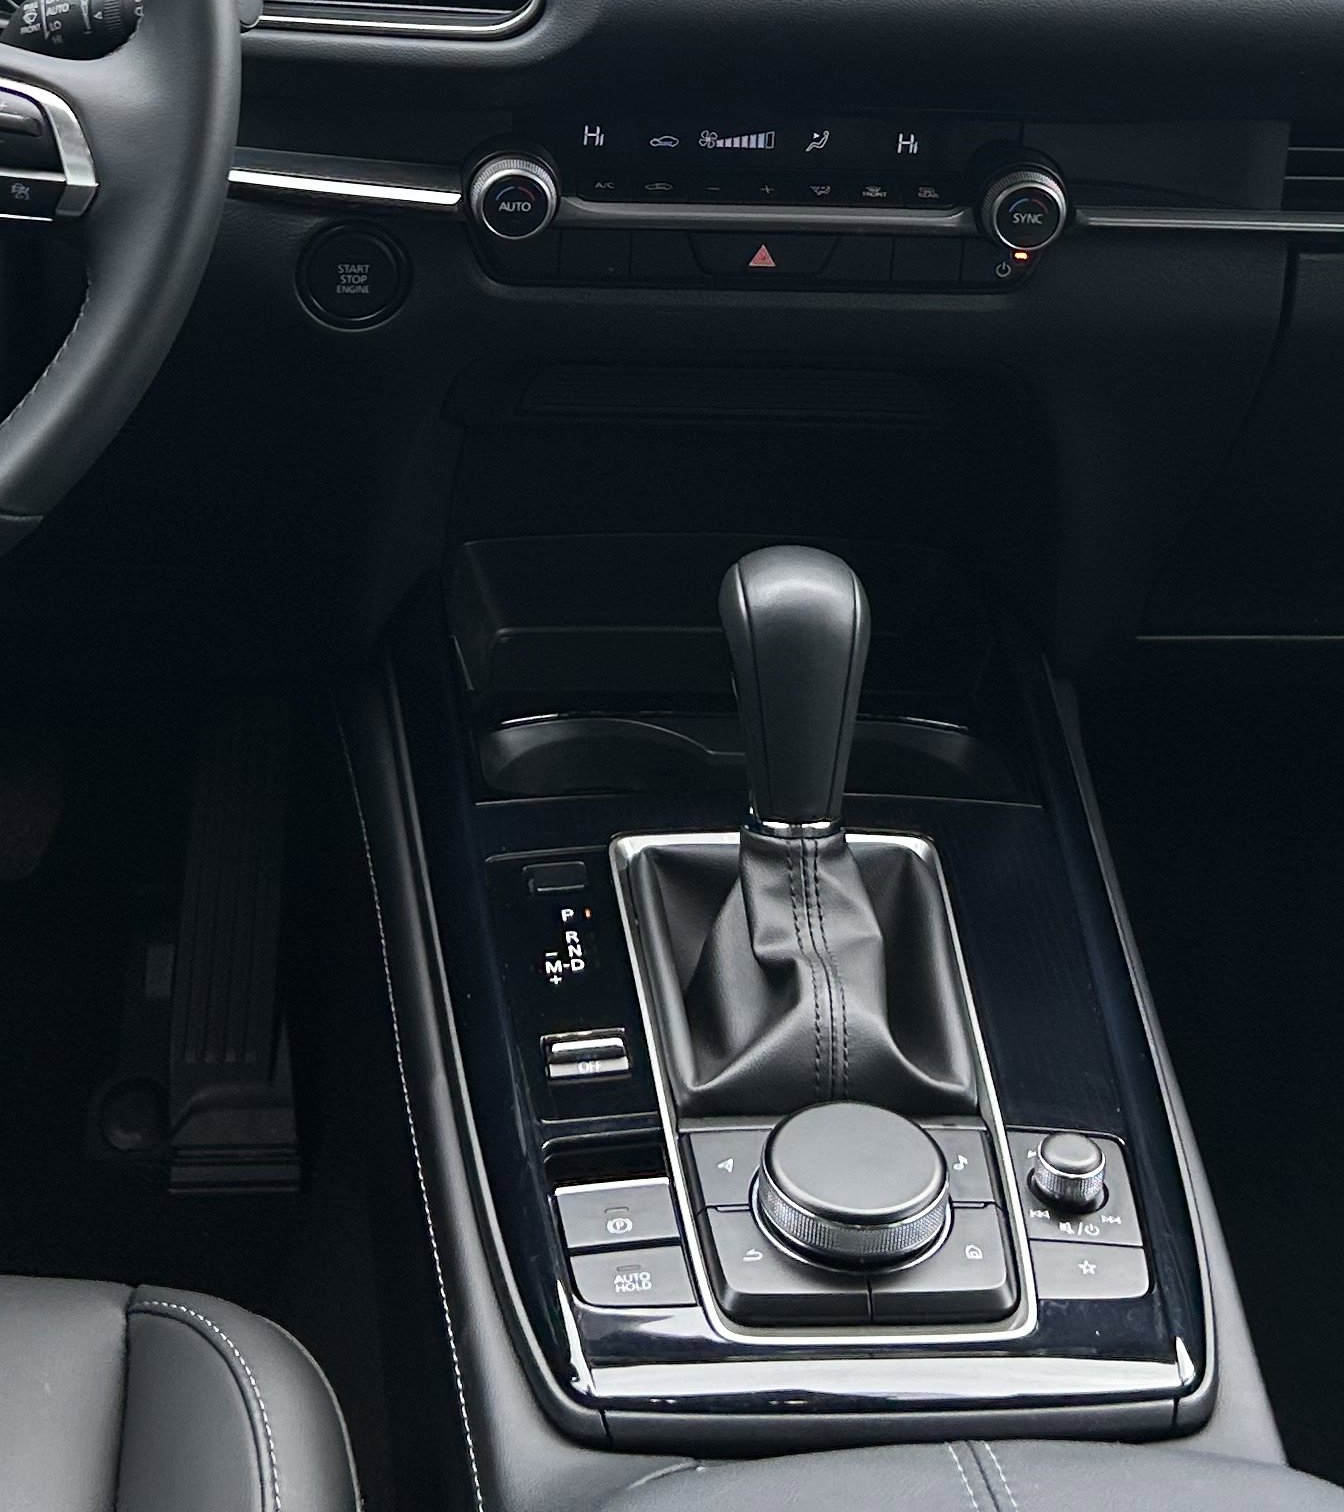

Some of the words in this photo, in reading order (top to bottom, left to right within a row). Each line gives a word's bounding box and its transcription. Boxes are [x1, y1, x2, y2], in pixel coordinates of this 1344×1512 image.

[46, 4, 70, 17] AUTO
[49, 20, 62, 31] LO
[595, 180, 616, 190] A/C
[498, 200, 532, 213] AUTO
[1012, 212, 1044, 226] SYNC
[337, 264, 370, 275] START
[339, 274, 368, 285] STOP
[336, 284, 370, 295] ENGINE
[560, 908, 575, 922] P
[565, 931, 580, 944] R
[567, 944, 583, 958] N
[614, 1271, 651, 1284] AUTO
[615, 1281, 652, 1294] HOLD
